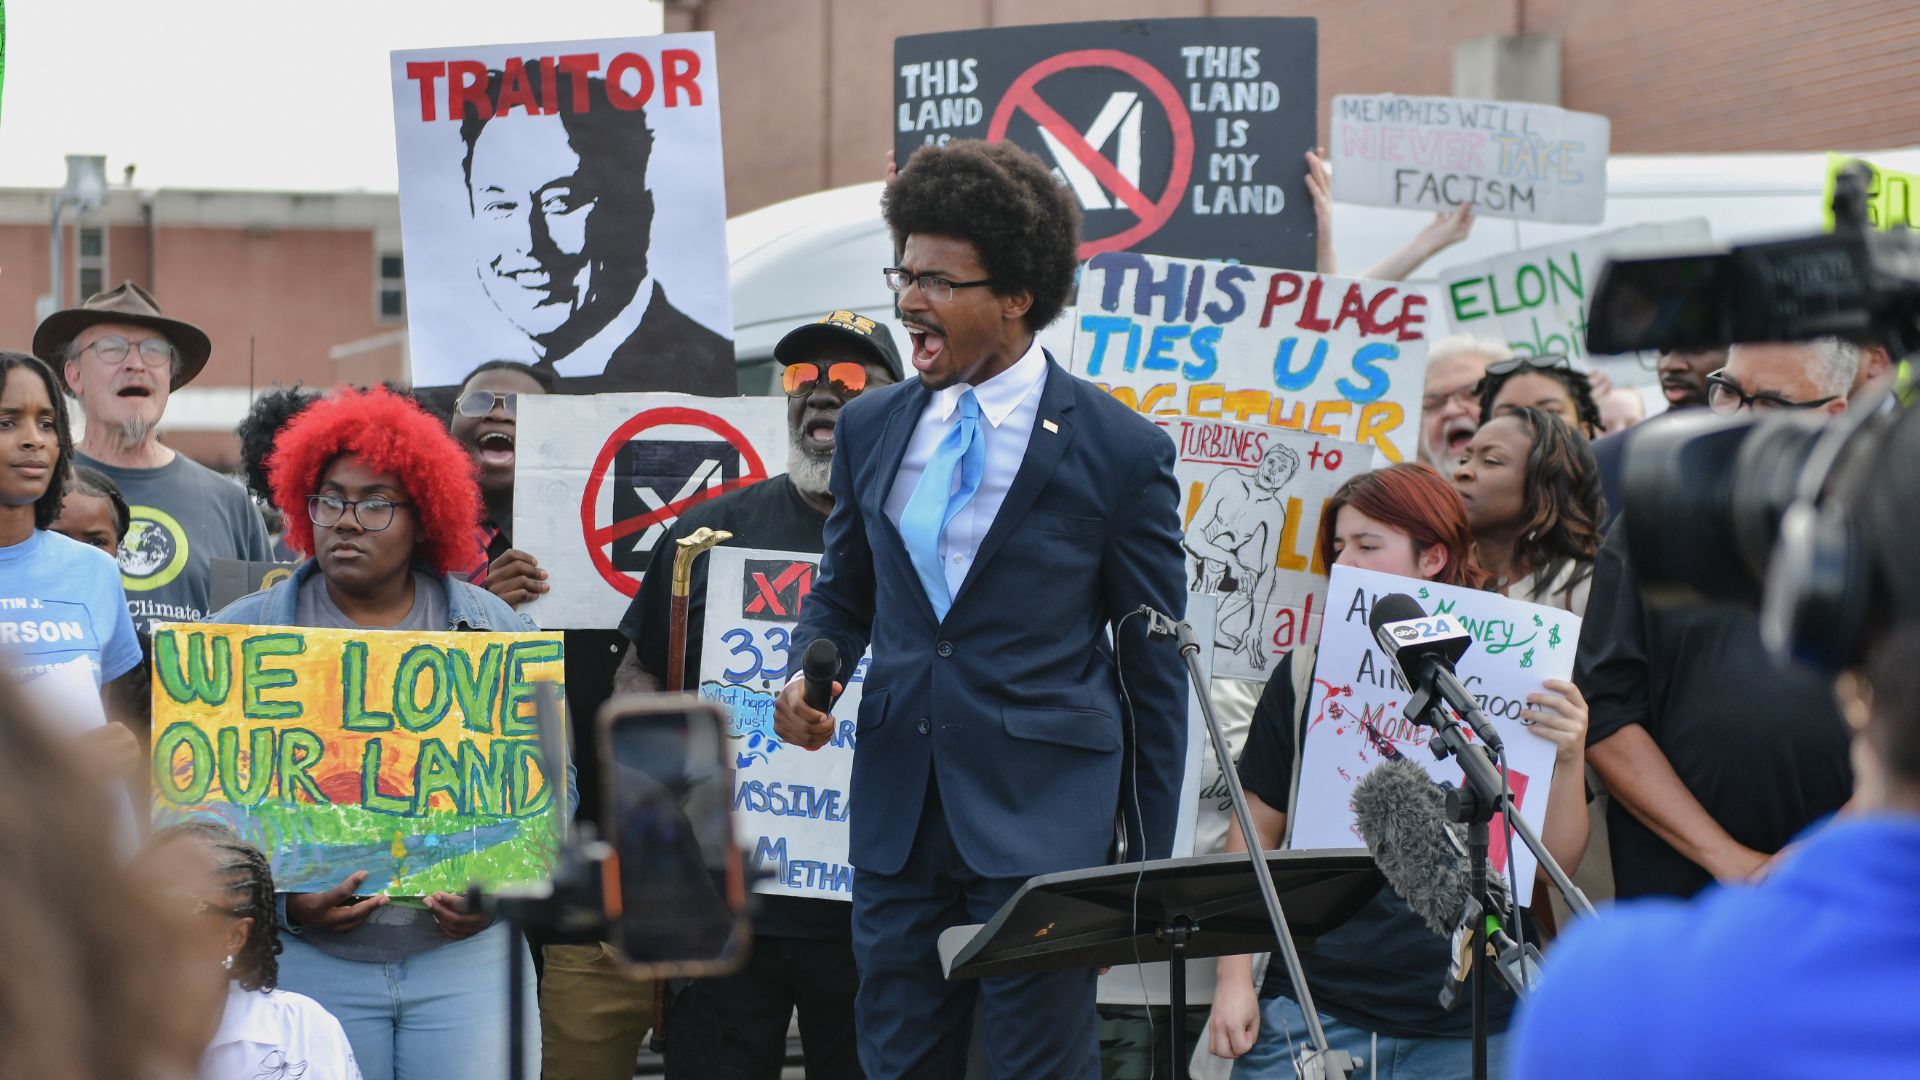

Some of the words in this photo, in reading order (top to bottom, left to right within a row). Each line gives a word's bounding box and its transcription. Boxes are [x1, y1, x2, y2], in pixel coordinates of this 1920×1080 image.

[900, 58, 979, 98] THIS
[1181, 46, 1261, 79] THIS
[407, 49, 702, 122] TRAITOR
[1190, 82, 1280, 112] LAND
[898, 97, 983, 132] LAND
[1341, 99, 1451, 123] MEMPHIS
[1457, 104, 1540, 135] WILL
[1216, 118, 1249, 148] IS
[1210, 153, 1260, 182] MY
[1342, 125, 1487, 171] NEVER
[1492, 132, 1585, 184] TAKE
[1193, 185, 1285, 215] LAND
[1394, 168, 1536, 213] FACISM
[1089, 252, 1255, 325] THIS
[1259, 272, 1428, 342] PLACE
[1449, 252, 1584, 321] ELON
[1081, 315, 1224, 381] TIES
[1274, 337, 1400, 404] US
[1095, 383, 1404, 463] GETHER
[1180, 421, 1269, 463] TURBINES
[1308, 441, 1343, 471] to
[31, 598, 44, 609] J.
[127, 600, 201, 622] Climate
[1394, 627, 1418, 639] abc
[1415, 619, 1450, 638] 24
[155, 630, 307, 719] WE
[342, 640, 564, 736] LOVE
[702, 687, 738, 706] What
[742, 690, 776, 716] happ
[736, 714, 768, 730] just
[153, 721, 330, 810] OUR
[361, 737, 556, 818] LAND
